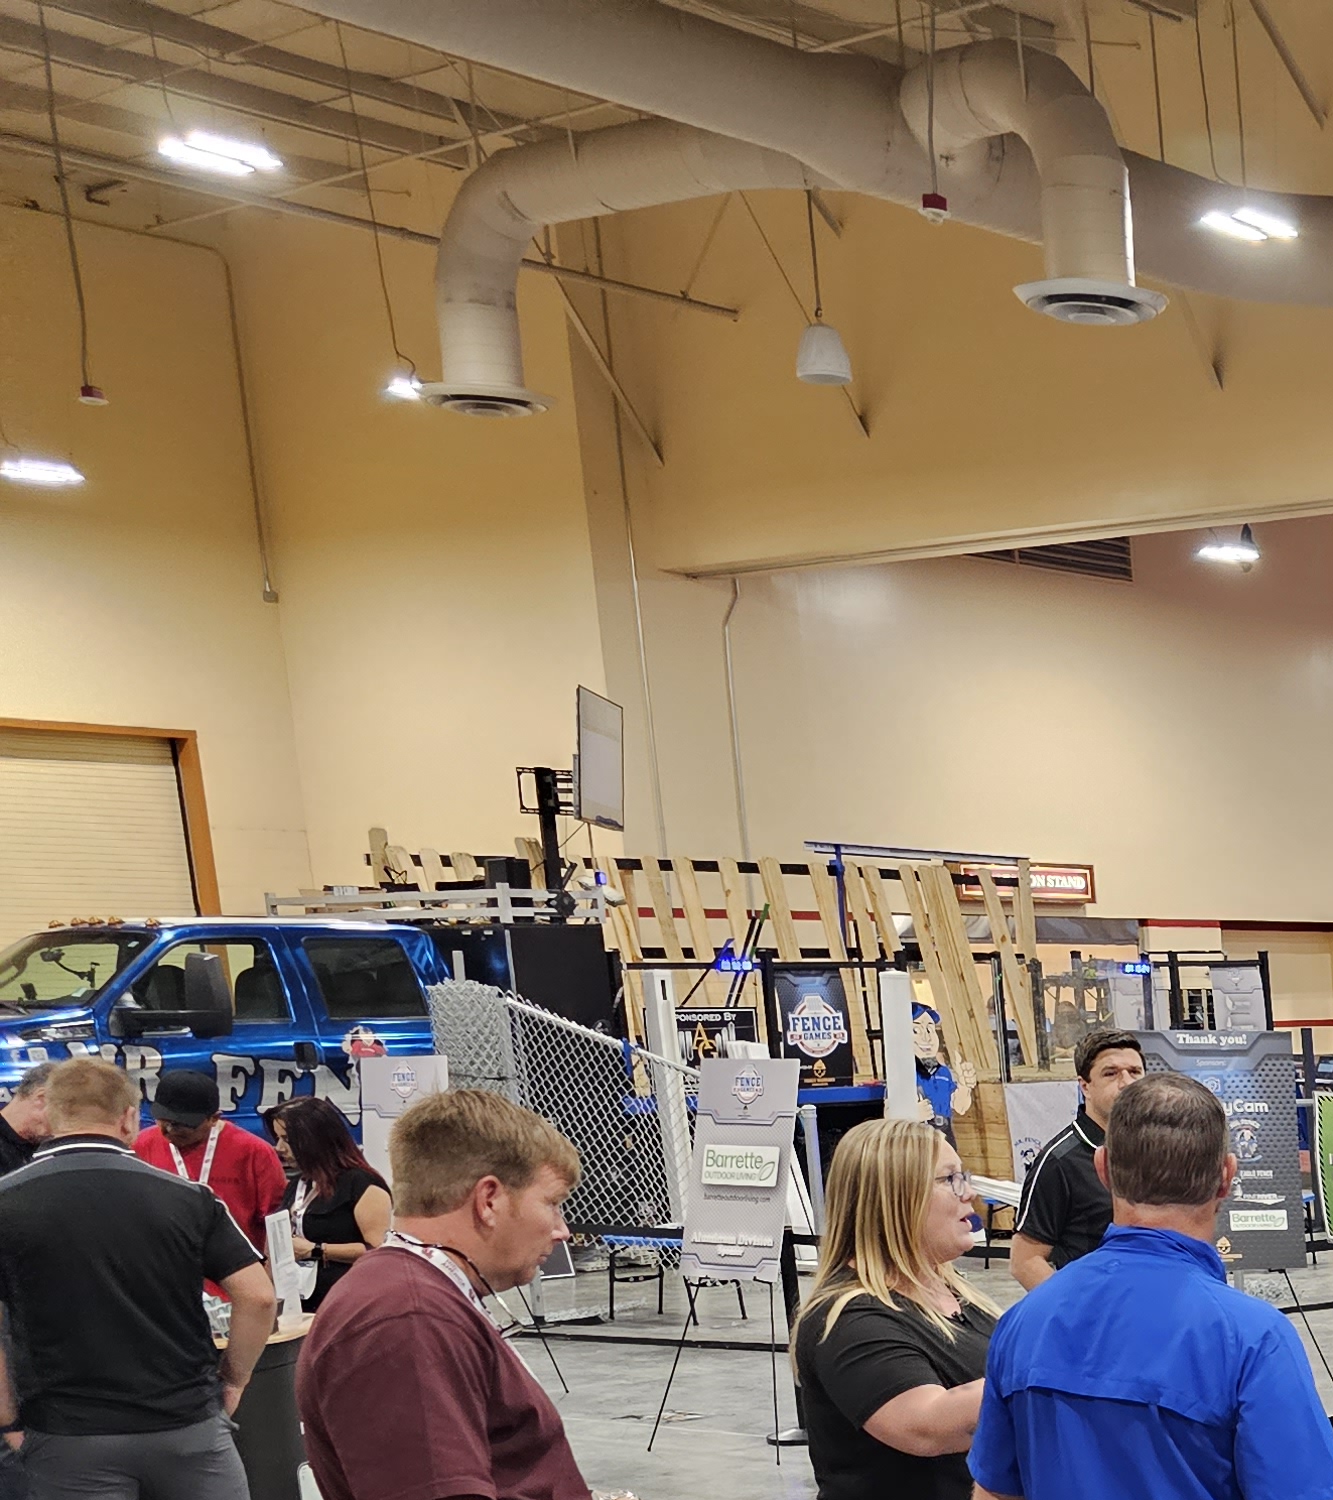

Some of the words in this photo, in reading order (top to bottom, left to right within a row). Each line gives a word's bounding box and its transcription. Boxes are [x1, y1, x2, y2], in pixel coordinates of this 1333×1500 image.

[1047, 875, 1086, 890] STAND
[791, 1016, 842, 1031] FENCE
[803, 1032, 832, 1040] GAMES
[1176, 1033, 1217, 1045] Thank
[1219, 1034, 1247, 1046] you!
[705, 1149, 763, 1169] Barrette
[1231, 1213, 1276, 1223] Barrette
